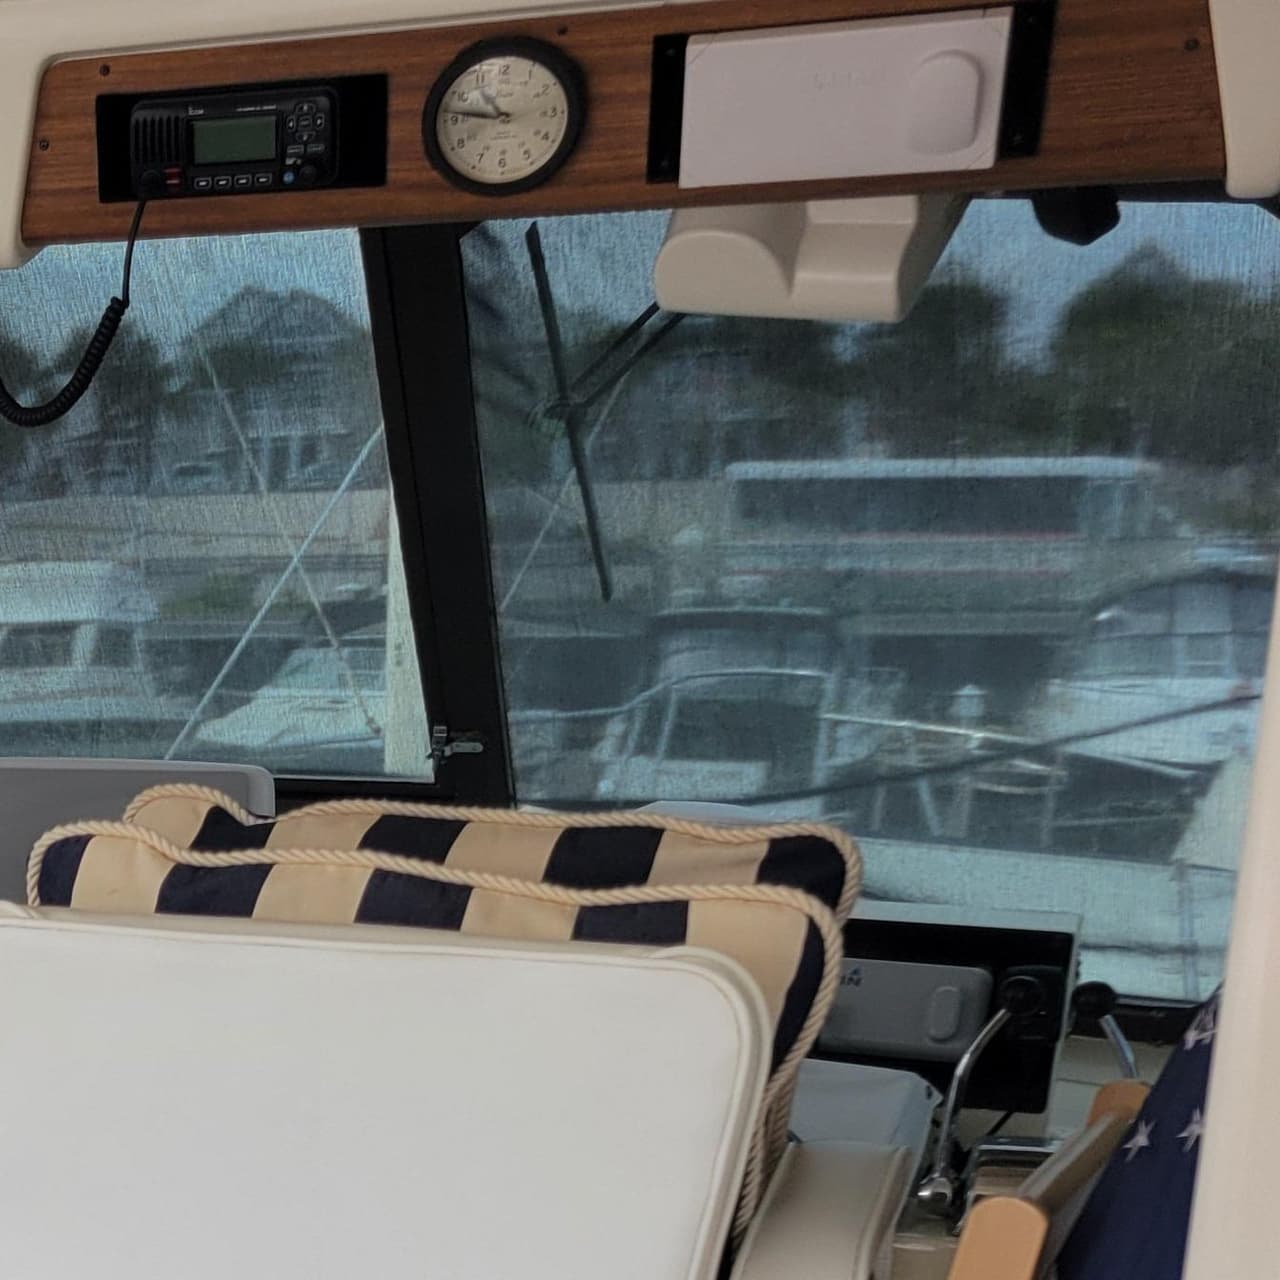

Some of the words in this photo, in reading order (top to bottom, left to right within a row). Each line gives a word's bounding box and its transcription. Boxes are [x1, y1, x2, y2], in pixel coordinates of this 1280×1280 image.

[498, 65, 510, 75] 12
[476, 74, 485, 84] 11
[542, 85, 551, 95] 2
[551, 107, 557, 118] 3
[450, 115, 458, 126] 9
[542, 131, 549, 141] 4
[457, 138, 465, 149] 8
[476, 152, 484, 163] 7
[523, 150, 531, 160] 5
[498, 158, 506, 168] 6
